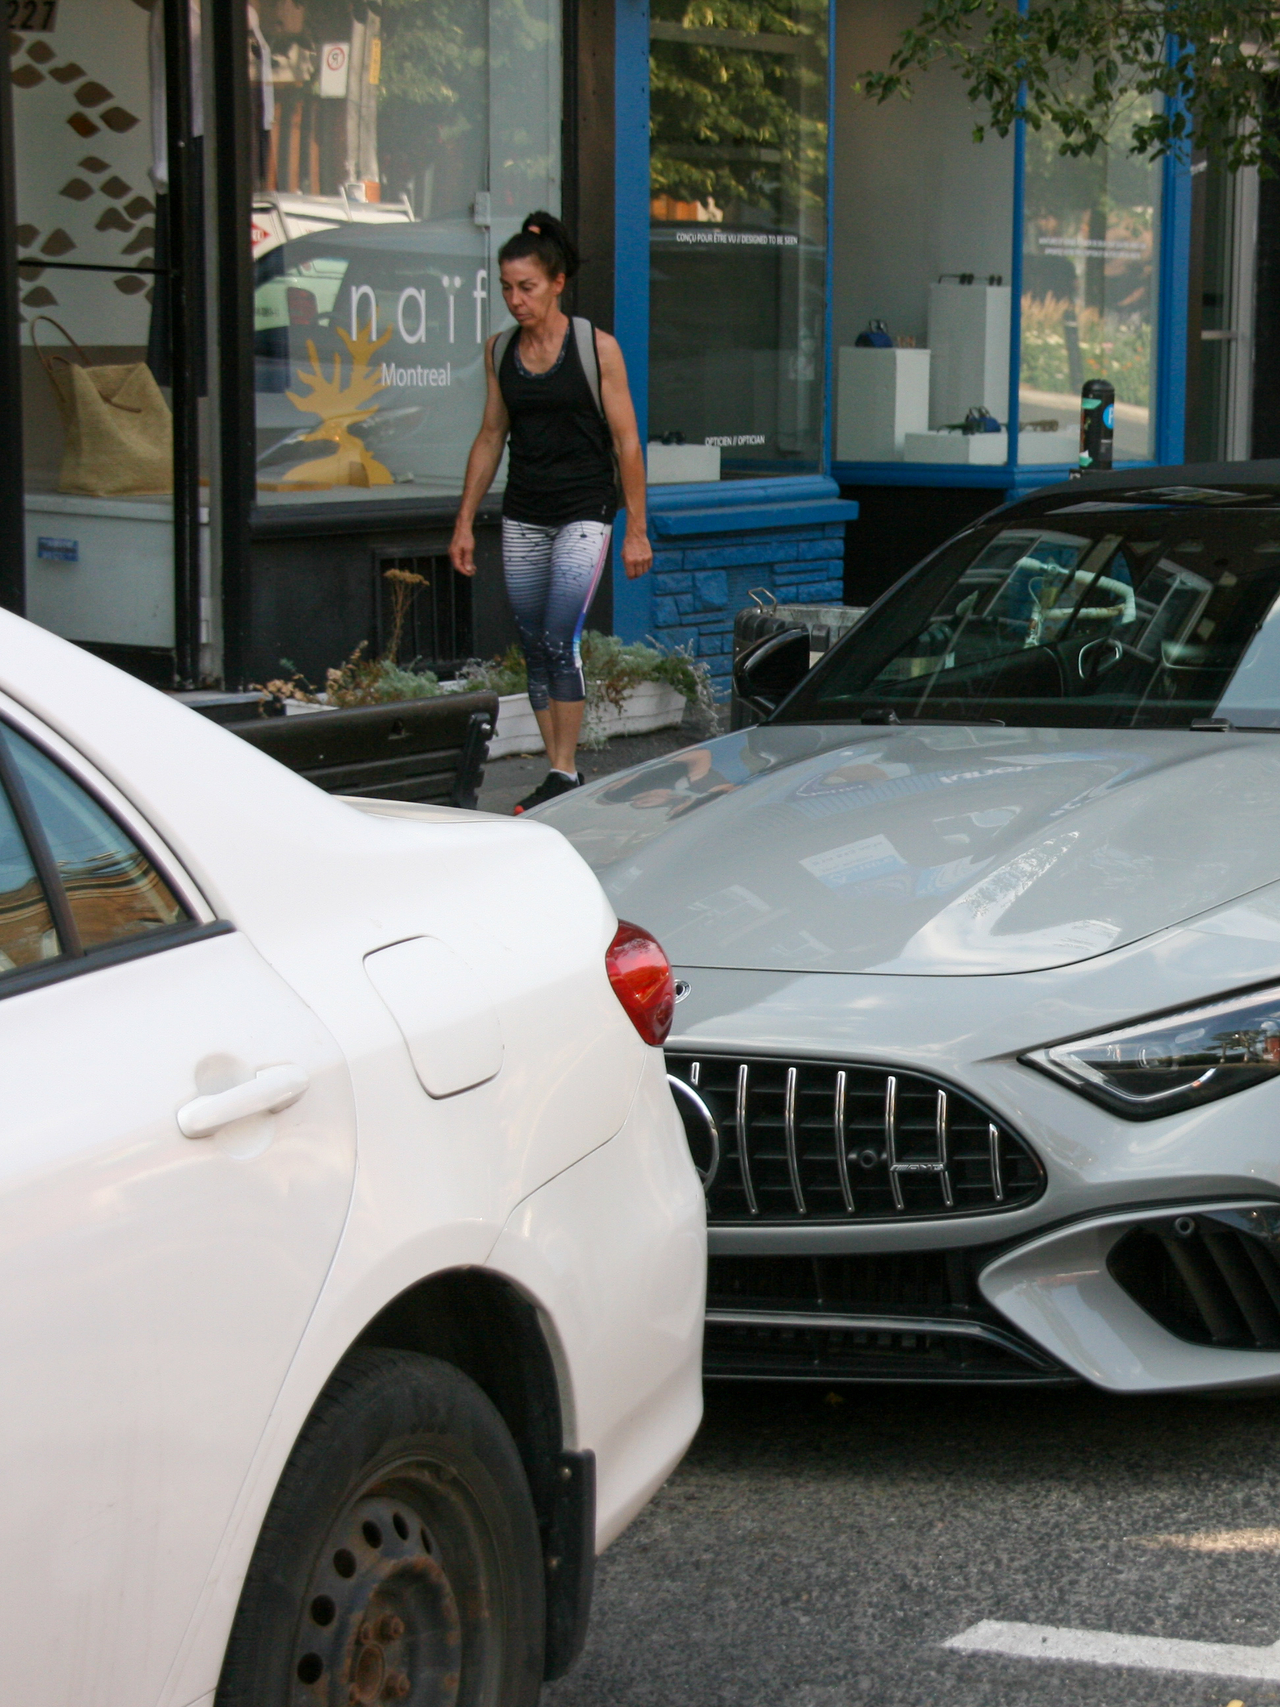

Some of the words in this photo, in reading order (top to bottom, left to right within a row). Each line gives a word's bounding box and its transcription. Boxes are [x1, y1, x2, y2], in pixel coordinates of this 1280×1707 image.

[6, 0, 57, 30] 227
[676, 232, 697, 244] CONÇU
[697, 232, 713, 243] POUR
[713, 231, 727, 244] ÊTRE
[727, 233, 736, 244] VU
[741, 234, 768, 245] DESIGNED
[768, 234, 776, 245] TO
[776, 235, 784, 245] BE
[784, 235, 798, 245] SEEN
[351, 268, 488, 344] naïf
[381, 362, 451, 386] Montreal
[705, 435, 732, 447] OPTICIEN
[738, 434, 766, 446] OPTICIAN
